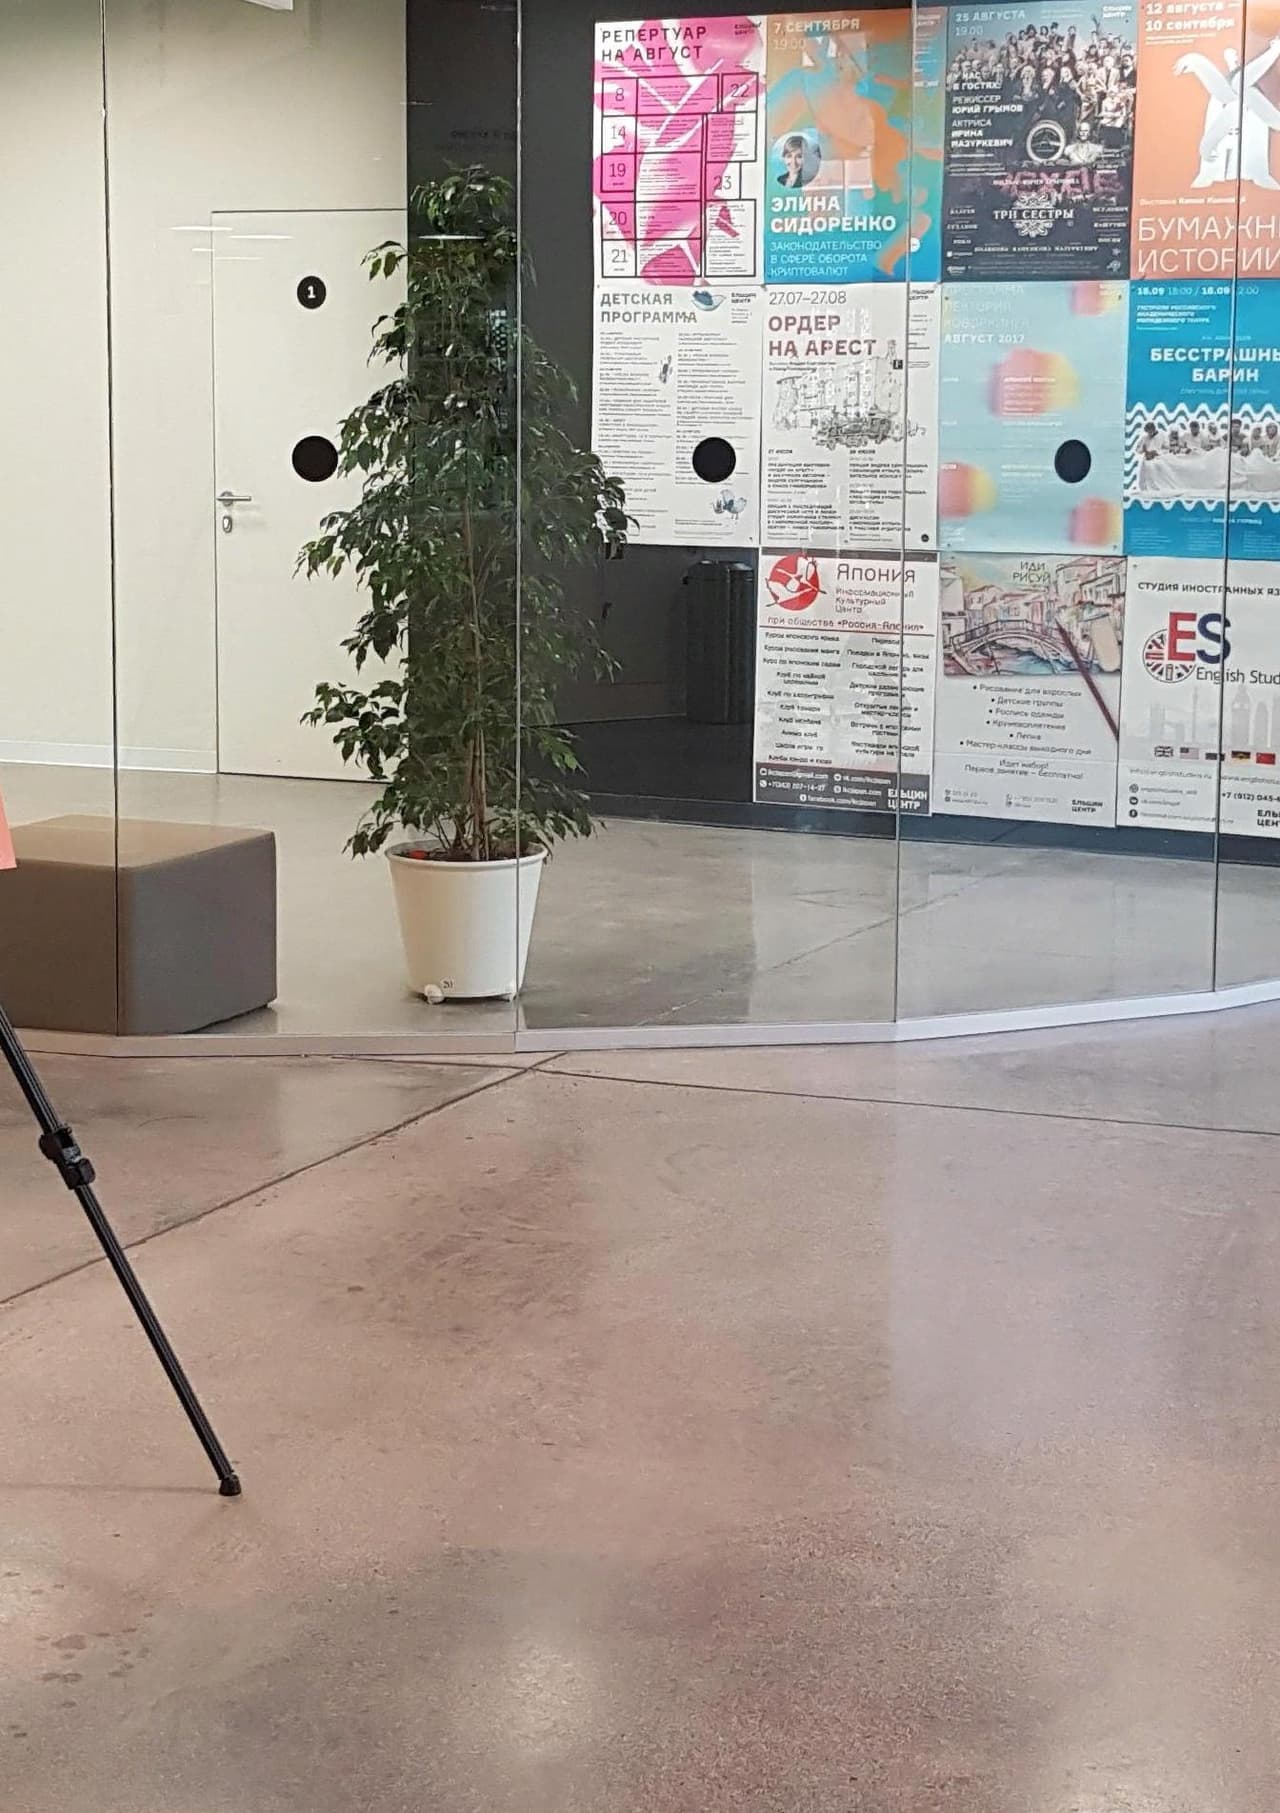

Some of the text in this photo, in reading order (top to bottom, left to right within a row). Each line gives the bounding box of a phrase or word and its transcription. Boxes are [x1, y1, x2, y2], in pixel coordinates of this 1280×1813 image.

[1145, 2, 1162, 15] 12
[973, 11, 1026, 21] АВГУСТА
[786, 18, 860, 32] СЕНТЯБРЯ
[1145, 16, 1235, 32] 10 сентября
[602, 26, 707, 42] РЕПЕРТУАР
[602, 46, 703, 62] НА АВГУСТ
[615, 88, 624, 101] 8
[609, 163, 626, 178] 19
[713, 175, 732, 190] 23
[771, 196, 840, 212] ЭЛИНА
[609, 211, 627, 226] 20
[993, 209, 1074, 220] ТРИ СЕСТРЫ
[771, 216, 896, 235] СИДОРЕНКО
[771, 240, 882, 252] ЗАКОНОДАТЕЛЬСТВО
[612, 249, 627, 263] 21
[780, 254, 814, 263] СФЕРЕ
[820, 254, 867, 263] ОБОРОТА
[771, 267, 849, 276] КРИПТОВАЛЮТ
[307, 286, 316, 298] 1
[600, 293, 673, 307] ДЕТСКАЯ
[601, 311, 697, 323] ПРОГРАММА
[769, 315, 841, 334] ОРДЕР
[944, 334, 1025, 344] АВГУСТ 2017
[769, 339, 876, 357] НА АРЕСТ
[1192, 368, 1259, 383] БАРИН
[837, 563, 916, 583] Япония
[1013, 572, 1051, 583] РИСУЙ
[1138, 582, 1179, 592] СТУДИЯ
[1168, 611, 1231, 665] ES
[1196, 667, 1245, 685] Engish
[888, 799, 920, 810] ЦНТР
